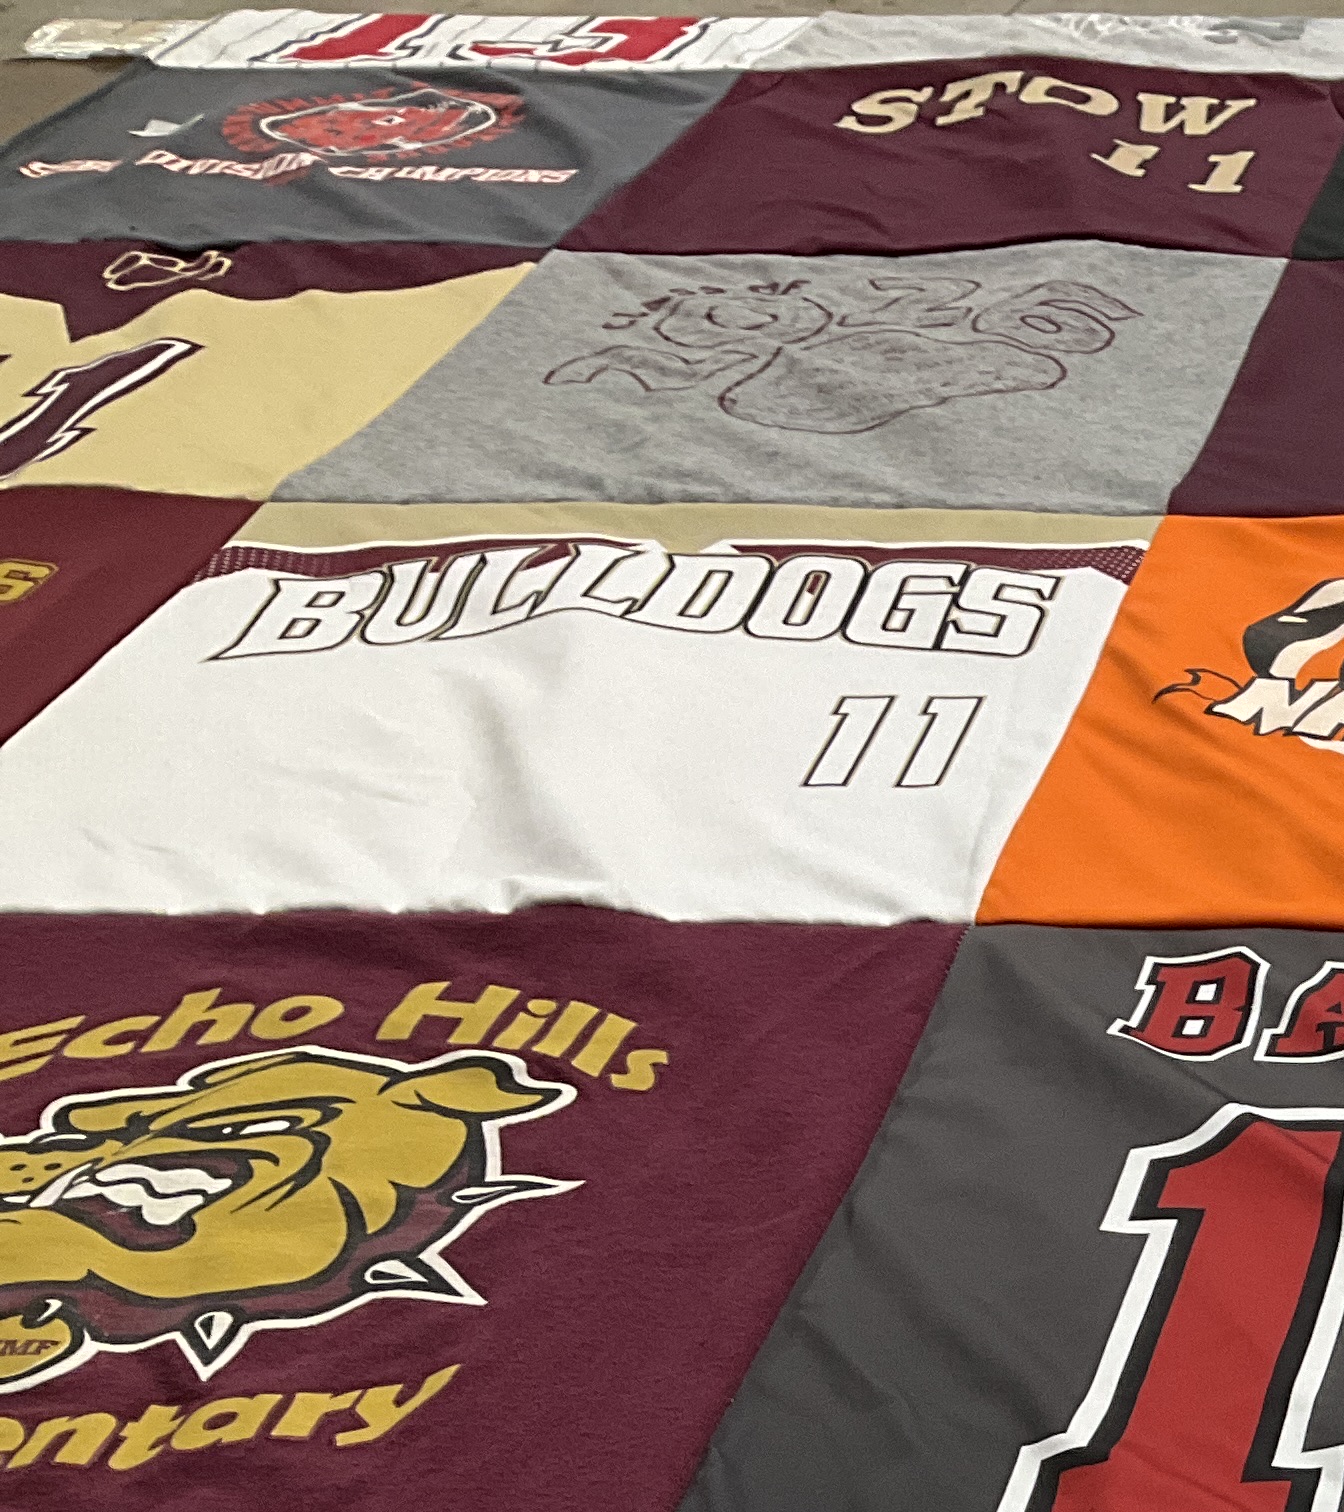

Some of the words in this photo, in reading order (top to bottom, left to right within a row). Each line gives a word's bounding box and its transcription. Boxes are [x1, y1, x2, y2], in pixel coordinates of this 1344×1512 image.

[834, 71, 1258, 135] STOW
[1090, 138, 1256, 194] 11
[201, 541, 1065, 663] BULLDOGS
[798, 695, 987, 789] 11
[0, 986, 344, 1082] Echo
[376, 980, 670, 1092] Hills
[0, 1363, 464, 1472] ntary
